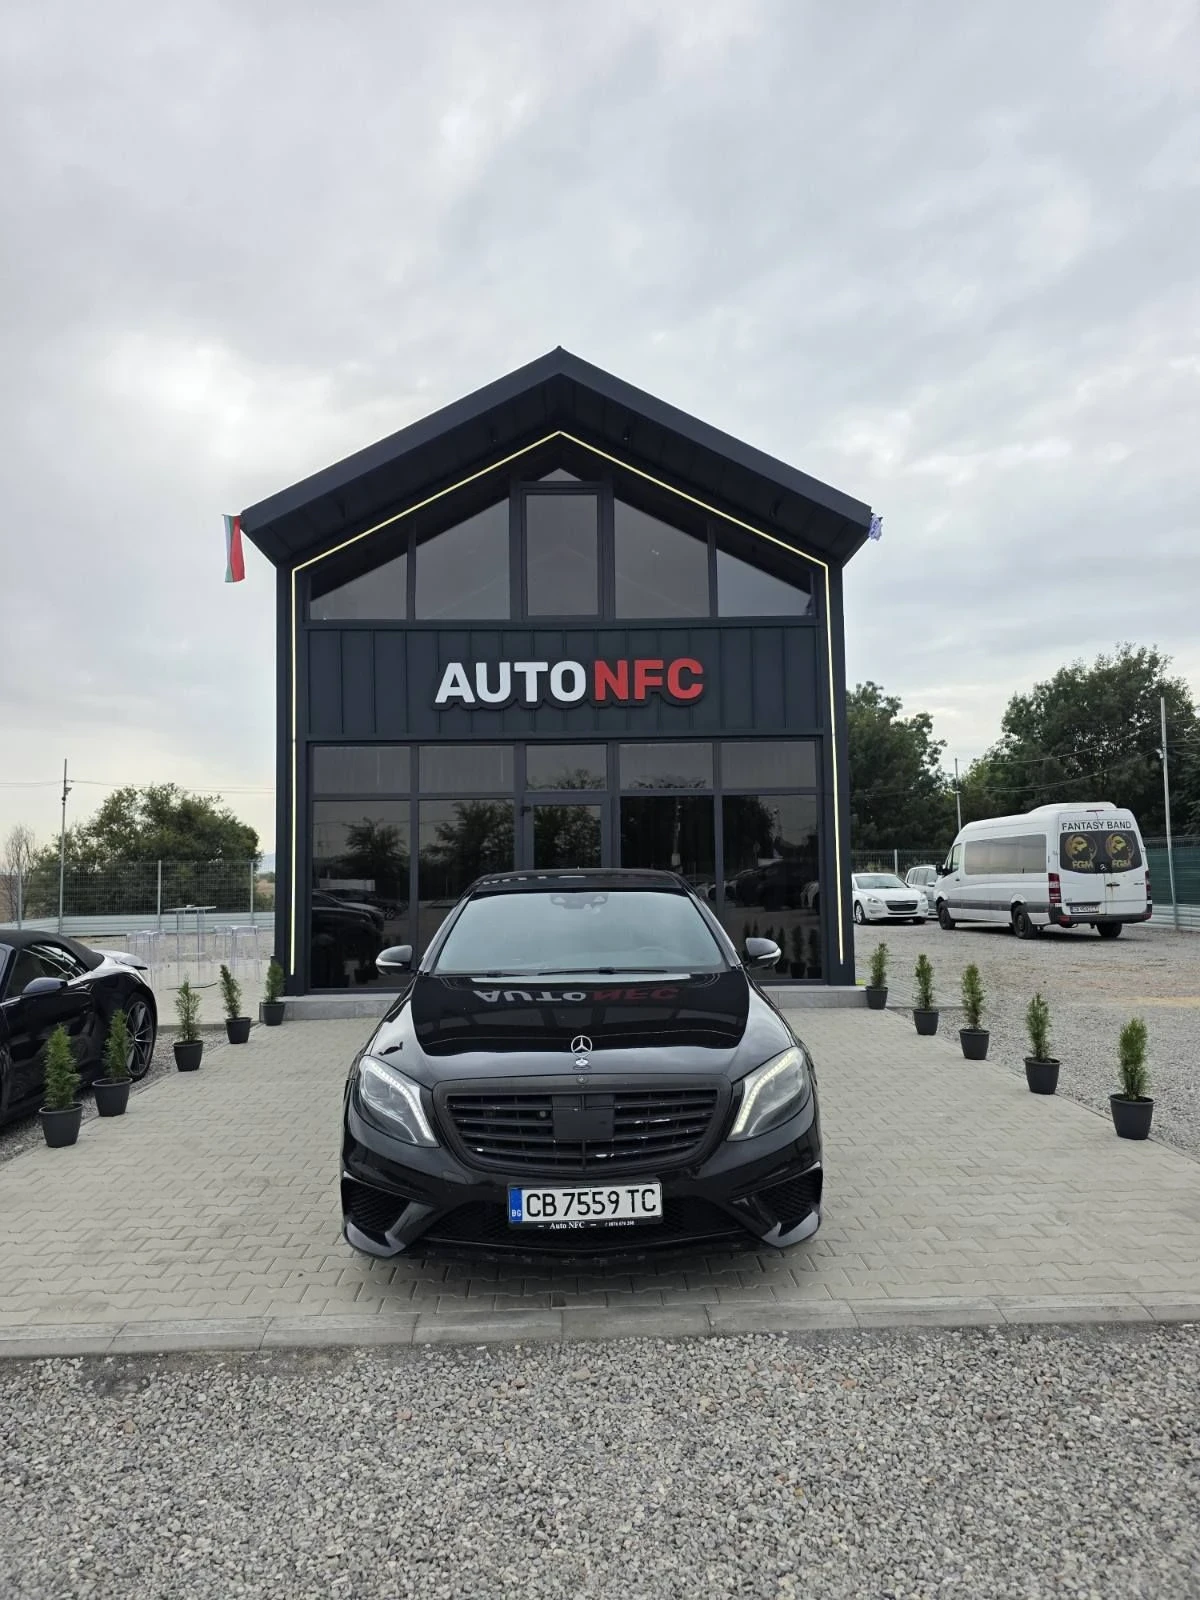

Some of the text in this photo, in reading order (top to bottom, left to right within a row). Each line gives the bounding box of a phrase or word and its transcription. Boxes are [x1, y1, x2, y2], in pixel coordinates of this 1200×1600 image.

[434, 657, 704, 704] AUTO NFC
[1061, 821, 1132, 831] FANTASY BAND
[526, 1188, 657, 1218] CB 7559 TC
[511, 1209, 522, 1217] BG
[549, 1221, 585, 1230] Auto NFC
